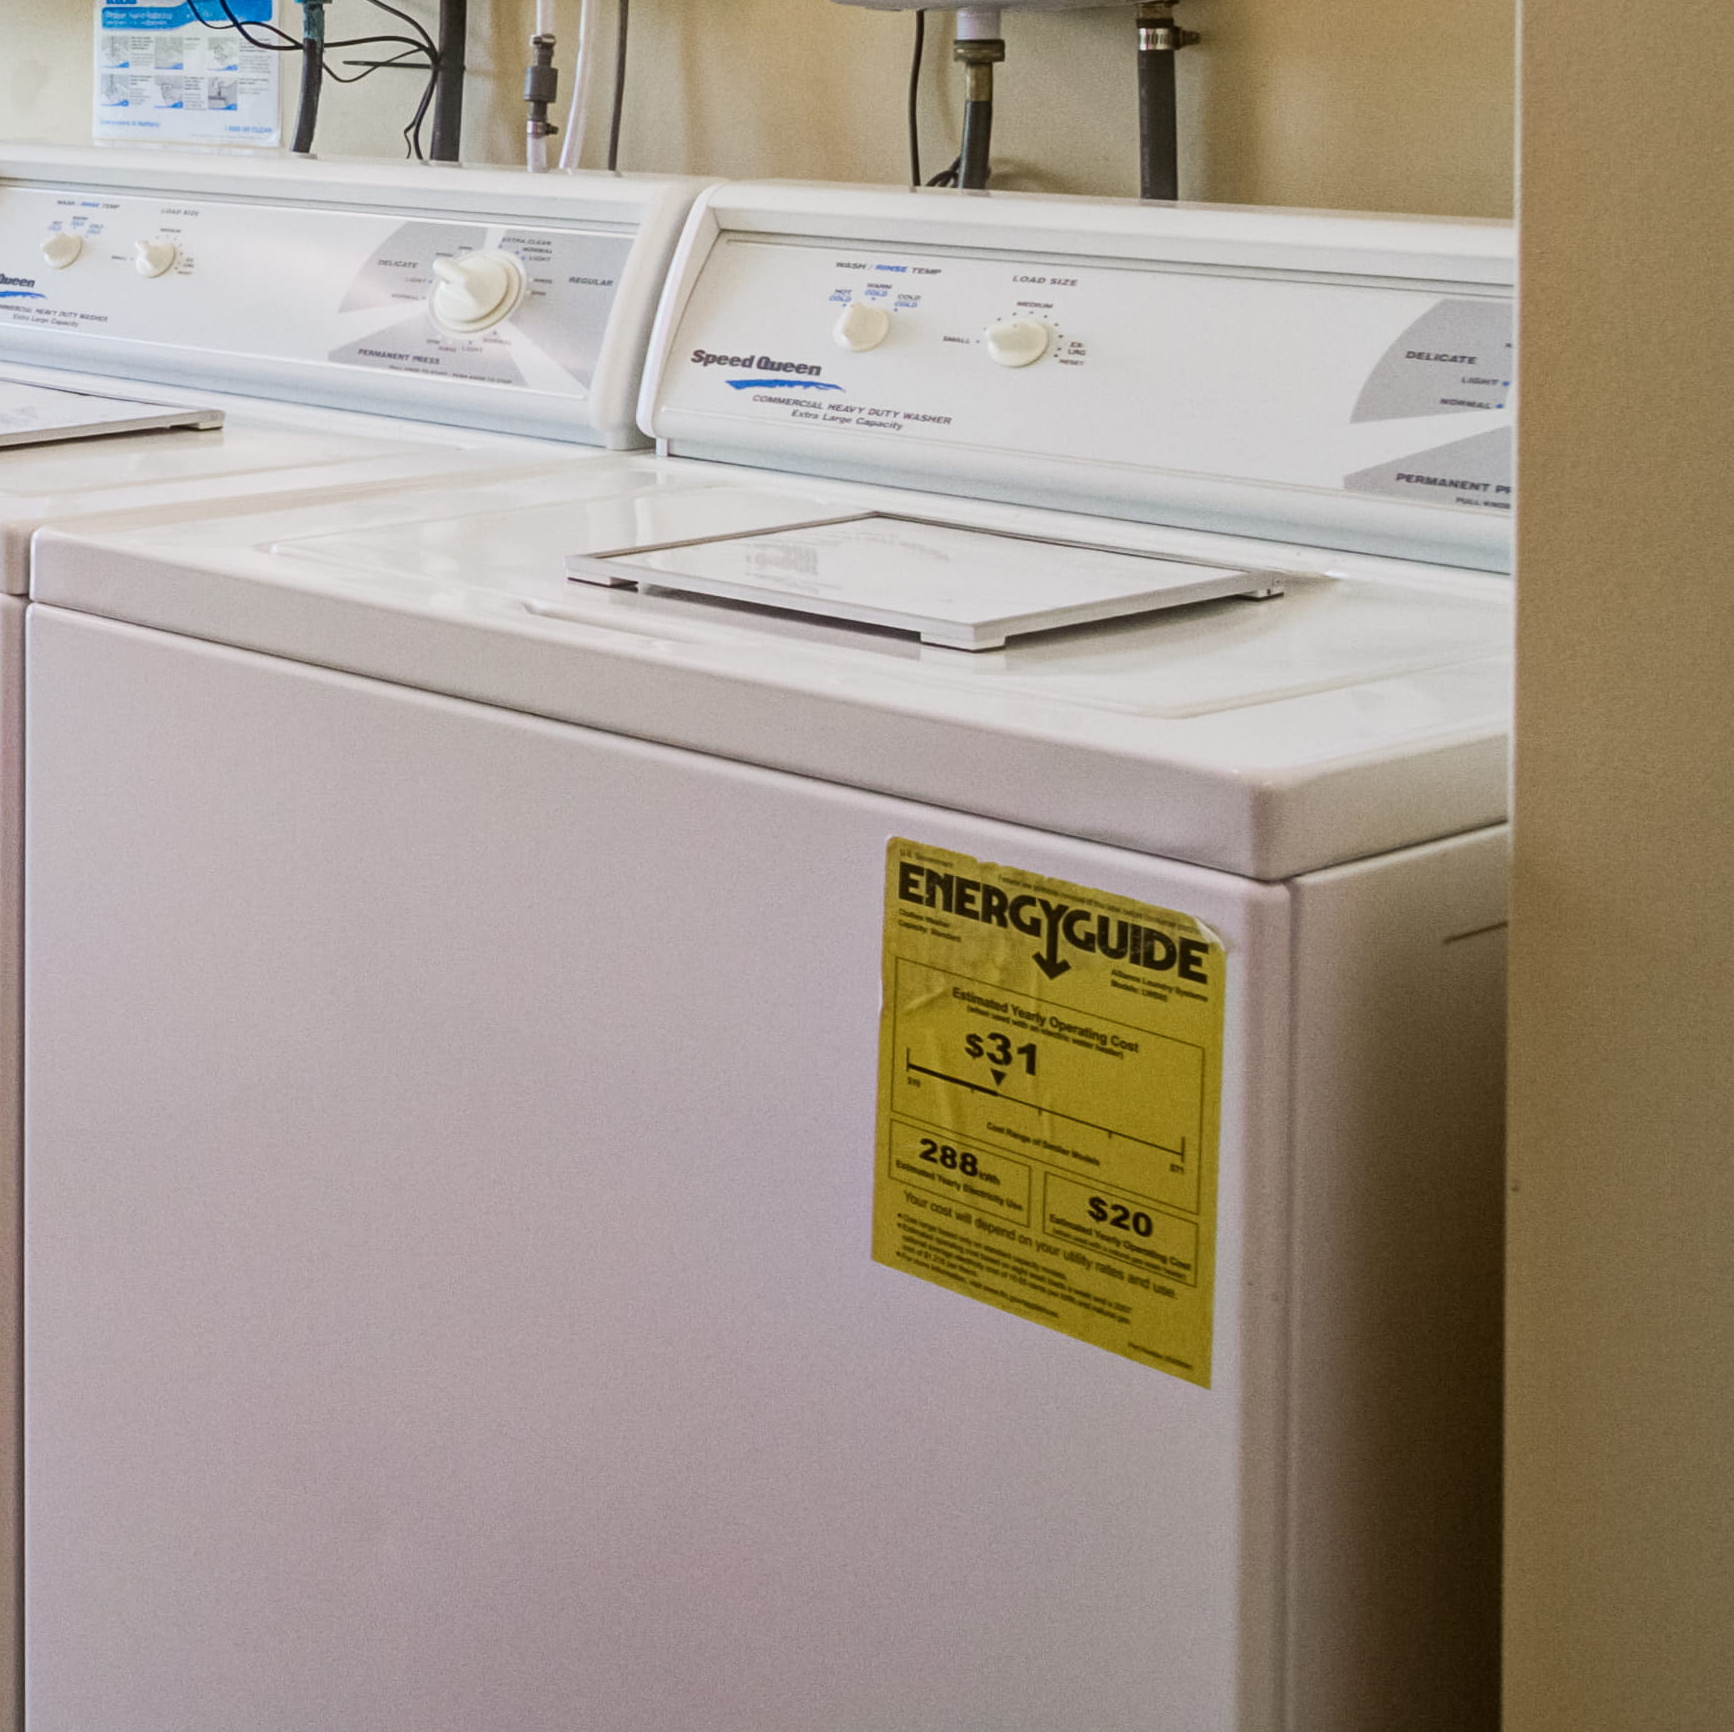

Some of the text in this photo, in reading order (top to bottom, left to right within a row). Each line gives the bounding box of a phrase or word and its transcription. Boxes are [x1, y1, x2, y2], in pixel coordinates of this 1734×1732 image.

[378, 259, 418, 268] DELICATE
[836, 262, 866, 270] WASH
[568, 277, 613, 286] REGULAR
[1012, 275, 1078, 286] LOAD SIZE
[864, 289, 888, 297] COLD
[35, 308, 58, 316] HEAVY
[1016, 301, 1053, 309] MEDIUM
[942, 335, 970, 344] SMALL
[358, 348, 440, 364] PERMANENT PRESS
[690, 349, 822, 376] Speed Queen
[1405, 350, 1477, 365] DELICATE
[1461, 376, 1499, 386] LIGHT
[752, 394, 952, 425] COMMERCIAL HEAVY DUTY WASHER
[1439, 398, 1492, 410] NORMAL
[791, 409, 903, 431] Extra Large Capacity
[1395, 472, 1491, 492] PERMANENT
[1455, 497, 1481, 506] PULL
[898, 861, 1209, 985] ENERGYGUIDE
[1142, 977, 1173, 994] Laundry
[1175, 987, 1209, 1002] Systems
[952, 987, 1139, 1053] Estimated Yearly Operating Cost
[964, 1031, 1037, 1076] $31
[986, 1121, 1004, 1133] Cost
[1005, 1128, 1030, 1143] Range
[1071, 1149, 1100, 1166] Models
[896, 1159, 1023, 1211] Estimated Yearly Electricity Use
[1087, 1196, 1153, 1238] $20
[904, 1190, 928, 1208] Your
[930, 1202, 953, 1217] cost
[955, 1211, 973, 1225] will
[974, 1217, 1016, 1241] depend
[1019, 1232, 1032, 1244] on
[1035, 1240, 1061, 1256] your
[1063, 1249, 1092, 1270] utility
[1095, 1262, 1125, 1280] rates
[1128, 1274, 1151, 1289] and
[1049, 1213, 1191, 1270] Estimated Yearly Operating Cost
